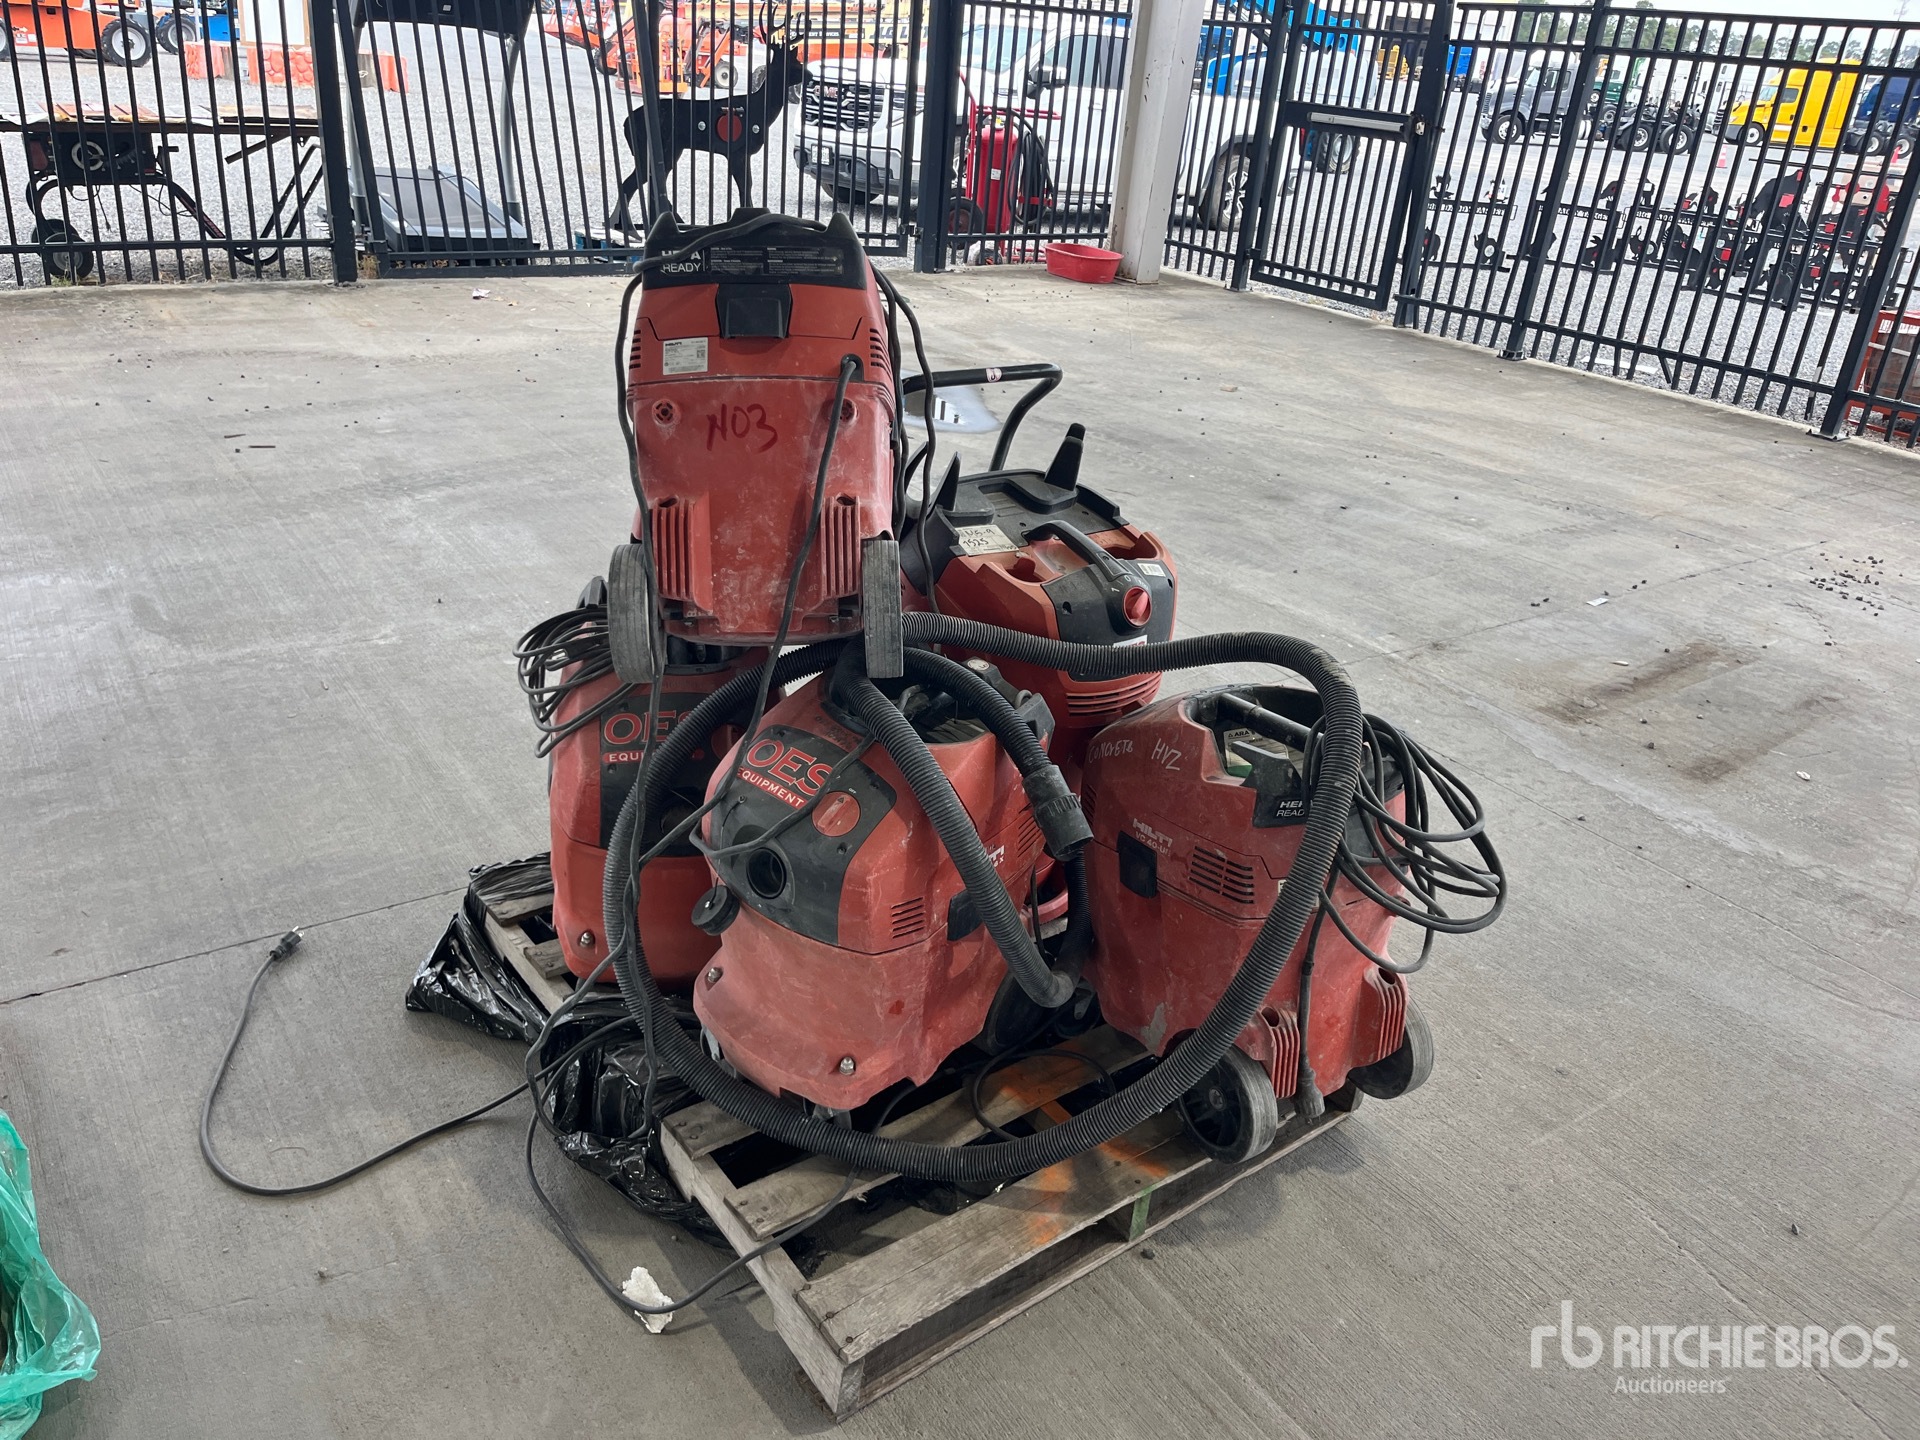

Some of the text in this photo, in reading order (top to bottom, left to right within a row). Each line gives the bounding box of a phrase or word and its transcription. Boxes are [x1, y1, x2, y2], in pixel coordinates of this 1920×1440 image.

[661, 250, 702, 260] HA
[663, 262, 702, 273] READY
[603, 709, 693, 745] OE
[746, 738, 834, 796] OES
[1280, 800, 1303, 808] HE
[1276, 809, 1305, 817] READ
[1132, 818, 1173, 847] HILTI
[1135, 831, 1146, 842] VC
